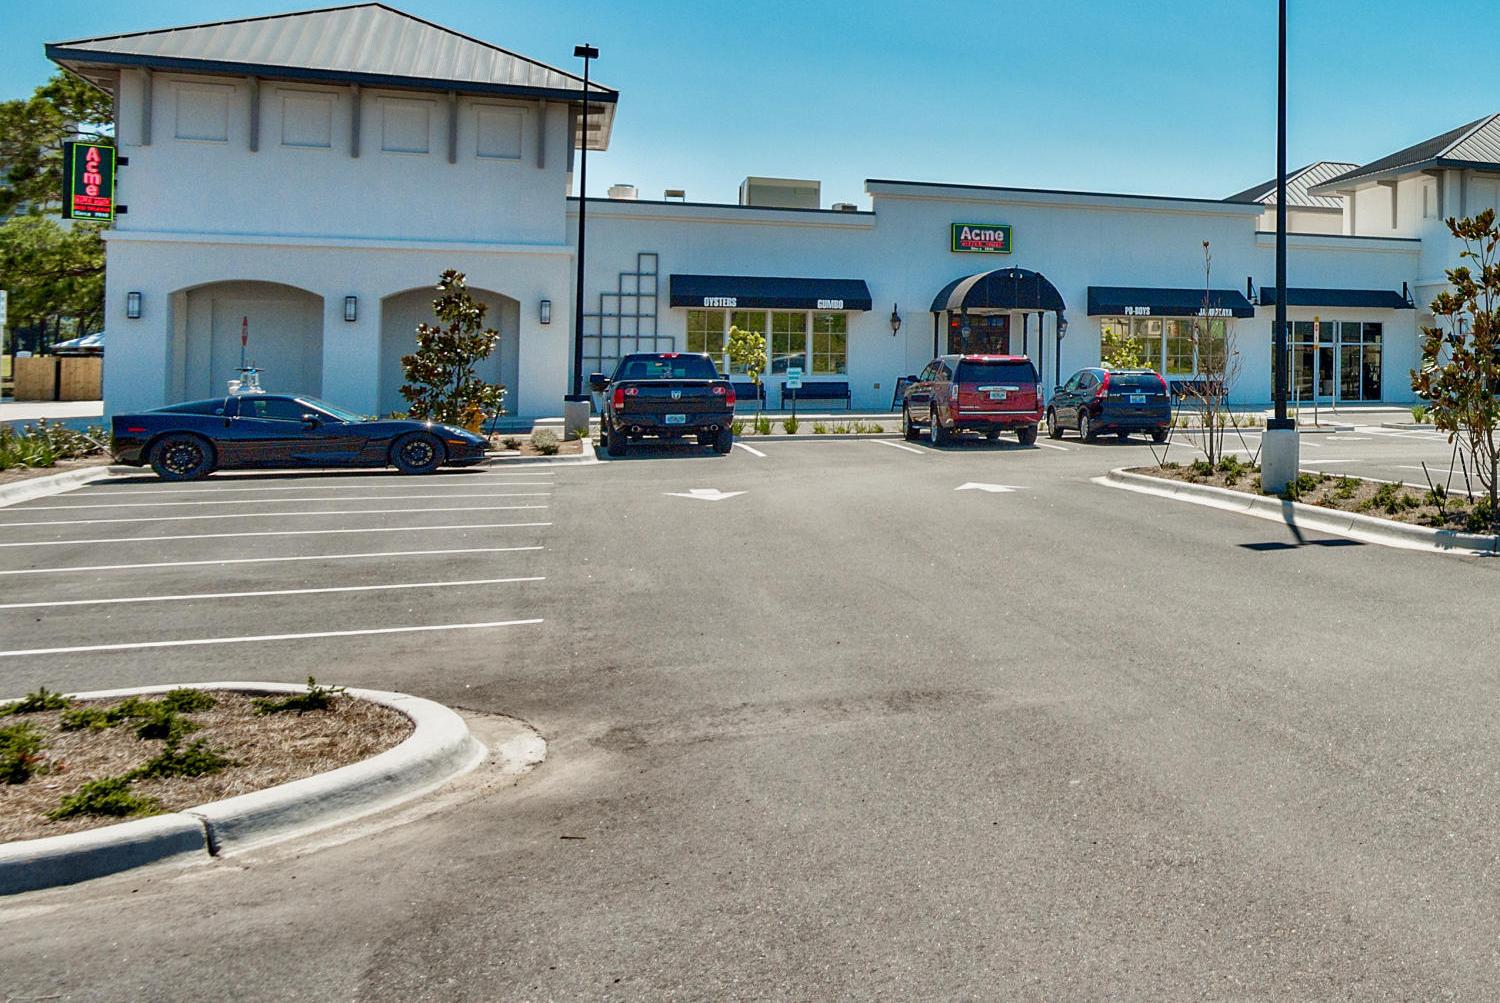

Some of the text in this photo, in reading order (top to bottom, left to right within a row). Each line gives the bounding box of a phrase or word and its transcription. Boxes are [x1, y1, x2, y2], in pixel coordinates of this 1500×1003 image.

[83, 147, 102, 197] Acme
[961, 226, 1004, 241] Acme
[704, 297, 844, 309] OYSTERS GUMBO
[1124, 306, 1151, 316] PO-BOYS
